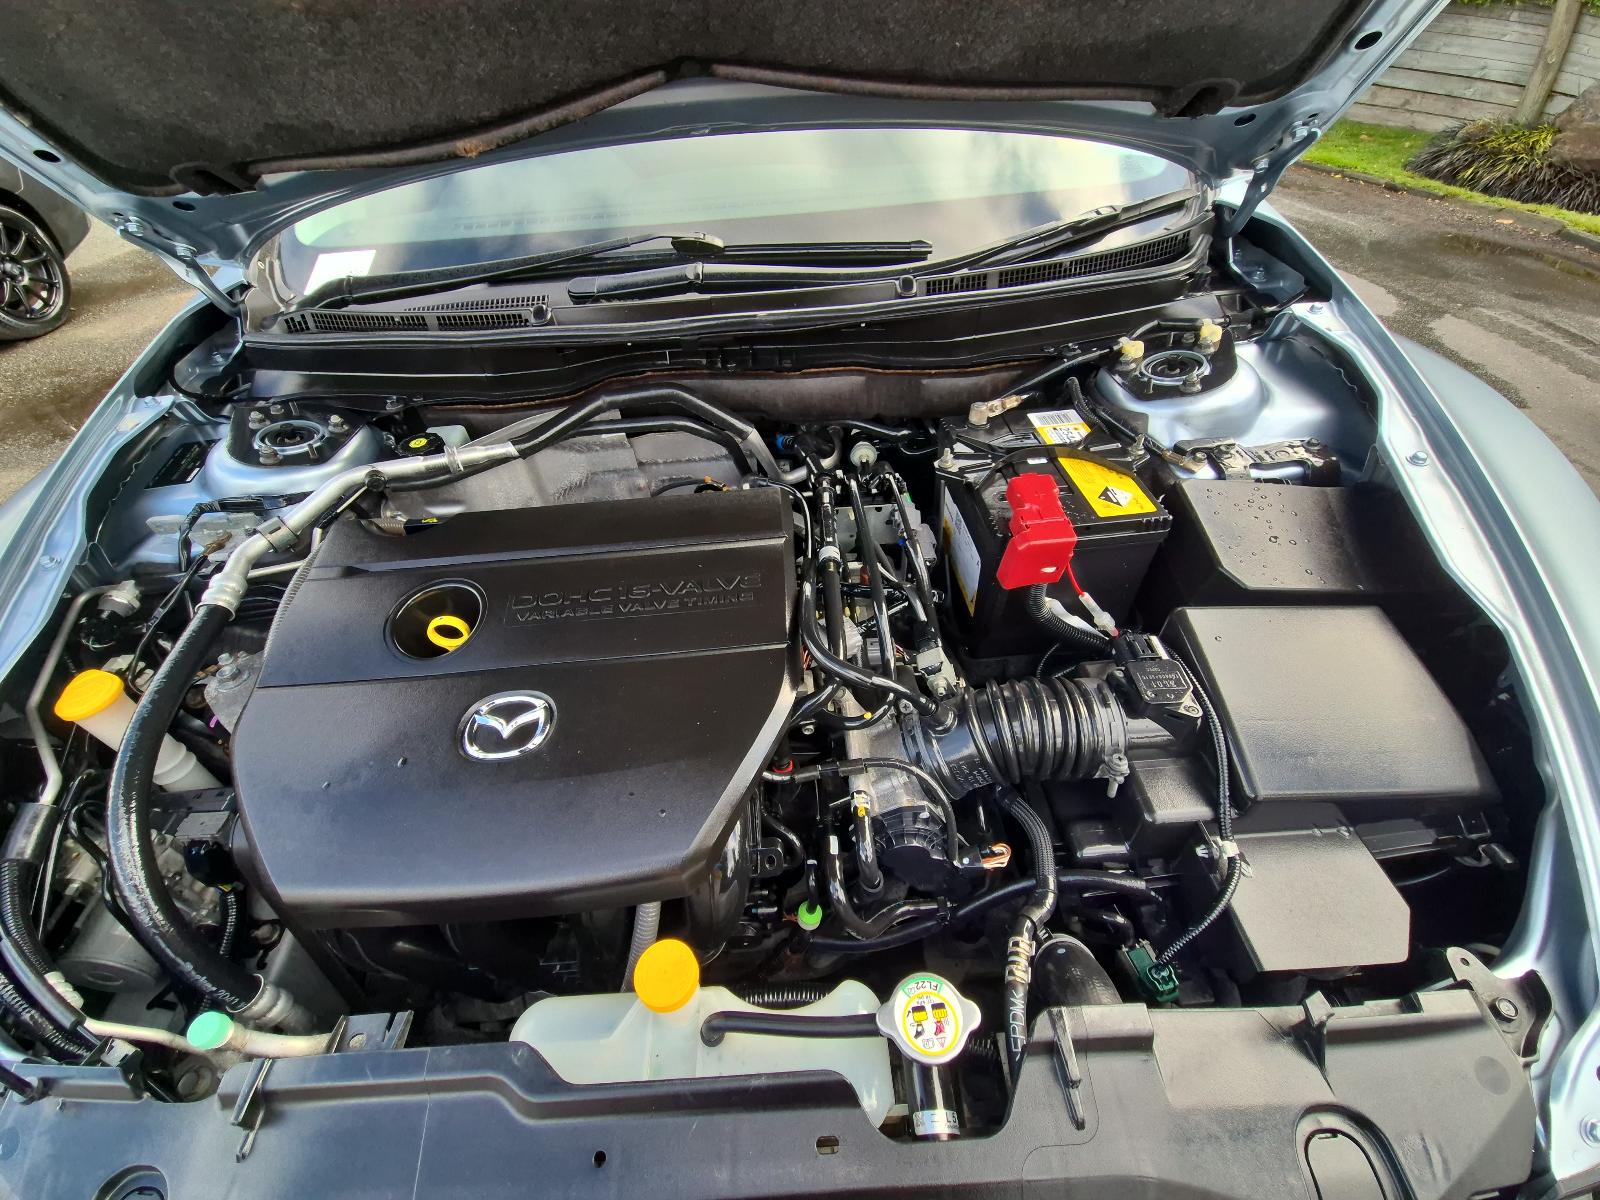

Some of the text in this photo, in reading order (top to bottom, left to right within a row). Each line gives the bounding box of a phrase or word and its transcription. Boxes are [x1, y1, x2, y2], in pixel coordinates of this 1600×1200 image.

[512, 586, 613, 610] DOHC
[516, 604, 614, 622] VARIABLE
[618, 599, 680, 614] VALVE
[915, 980, 939, 991] FL22
